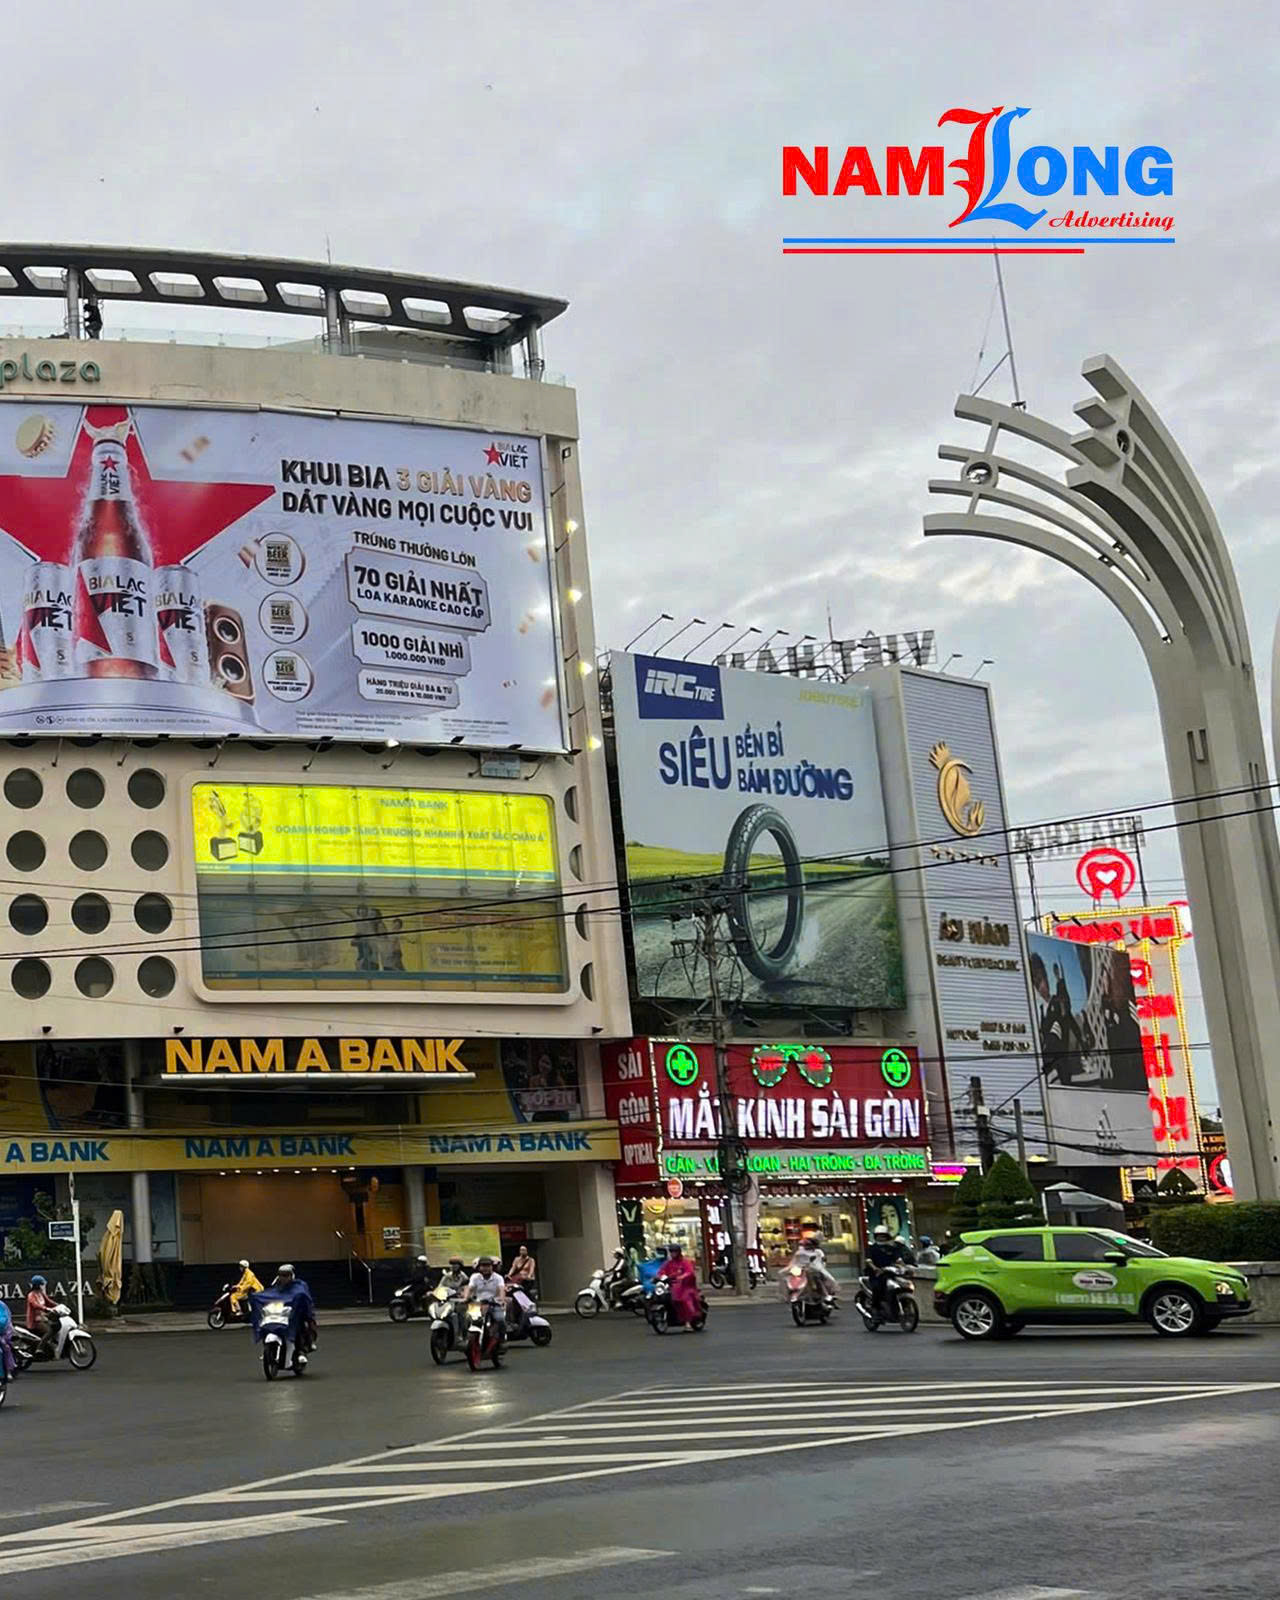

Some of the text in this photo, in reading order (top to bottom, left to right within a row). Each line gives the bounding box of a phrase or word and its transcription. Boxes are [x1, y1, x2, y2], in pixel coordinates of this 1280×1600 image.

[281, 459, 533, 504] KHUI BIA 3 GIẢI VÀNG
[331, 490, 392, 519] VÀNG
[398, 502, 435, 529] MỌI
[440, 500, 496, 532] CUỘC
[499, 510, 534, 532] VUI
[353, 531, 477, 568] TRÚNG THƯỞNG LỚN
[353, 565, 484, 607] 70 GIẢI NHẤT
[357, 588, 485, 620] LOA KARAOKE CAO CẤP
[361, 631, 464, 660] 1000 GIẢI NHÌ
[385, 650, 426, 665] 1.000.000
[694, 686, 717, 703] TIRE
[659, 725, 732, 790] SIÊU
[735, 723, 764, 759] BỀN
[737, 759, 854, 801] BÁM ĐƯỜNG
[165, 1038, 469, 1074] NAM A BANK
[618, 1048, 643, 1080] SÀI
[619, 1091, 651, 1126] GÒN
[737, 1090, 806, 1140] KÍNH
[811, 1089, 859, 1140] SÀI
[864, 1089, 921, 1139] GÒN
[4, 1142, 26, 1163] A
[31, 1140, 111, 1163] BANK
[185, 1134, 357, 1159] NAM A BANK
[428, 1131, 593, 1154] NAM A BANK
[789, 1157, 811, 1172] HAI
